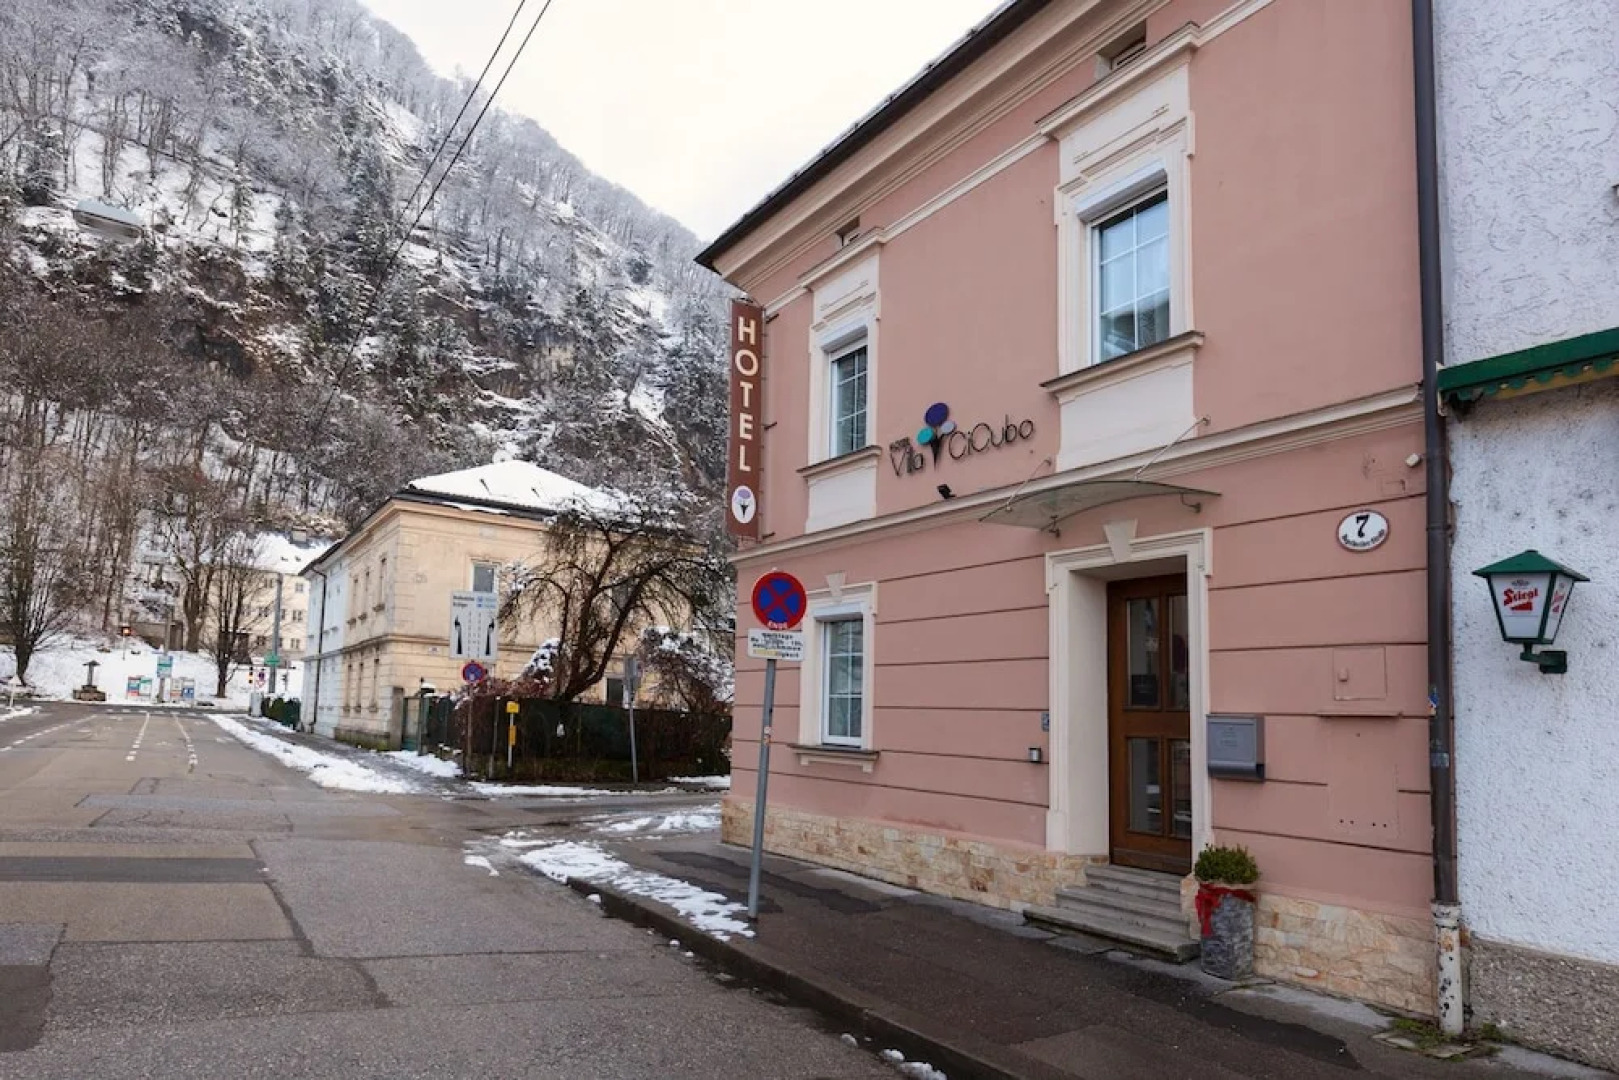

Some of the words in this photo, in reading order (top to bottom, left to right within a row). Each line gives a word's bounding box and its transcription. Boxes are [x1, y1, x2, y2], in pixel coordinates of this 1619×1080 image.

[735, 316, 759, 472] HOTEL
[1356, 514, 1370, 538] 7
[1503, 587, 1539, 606] Stiegl
